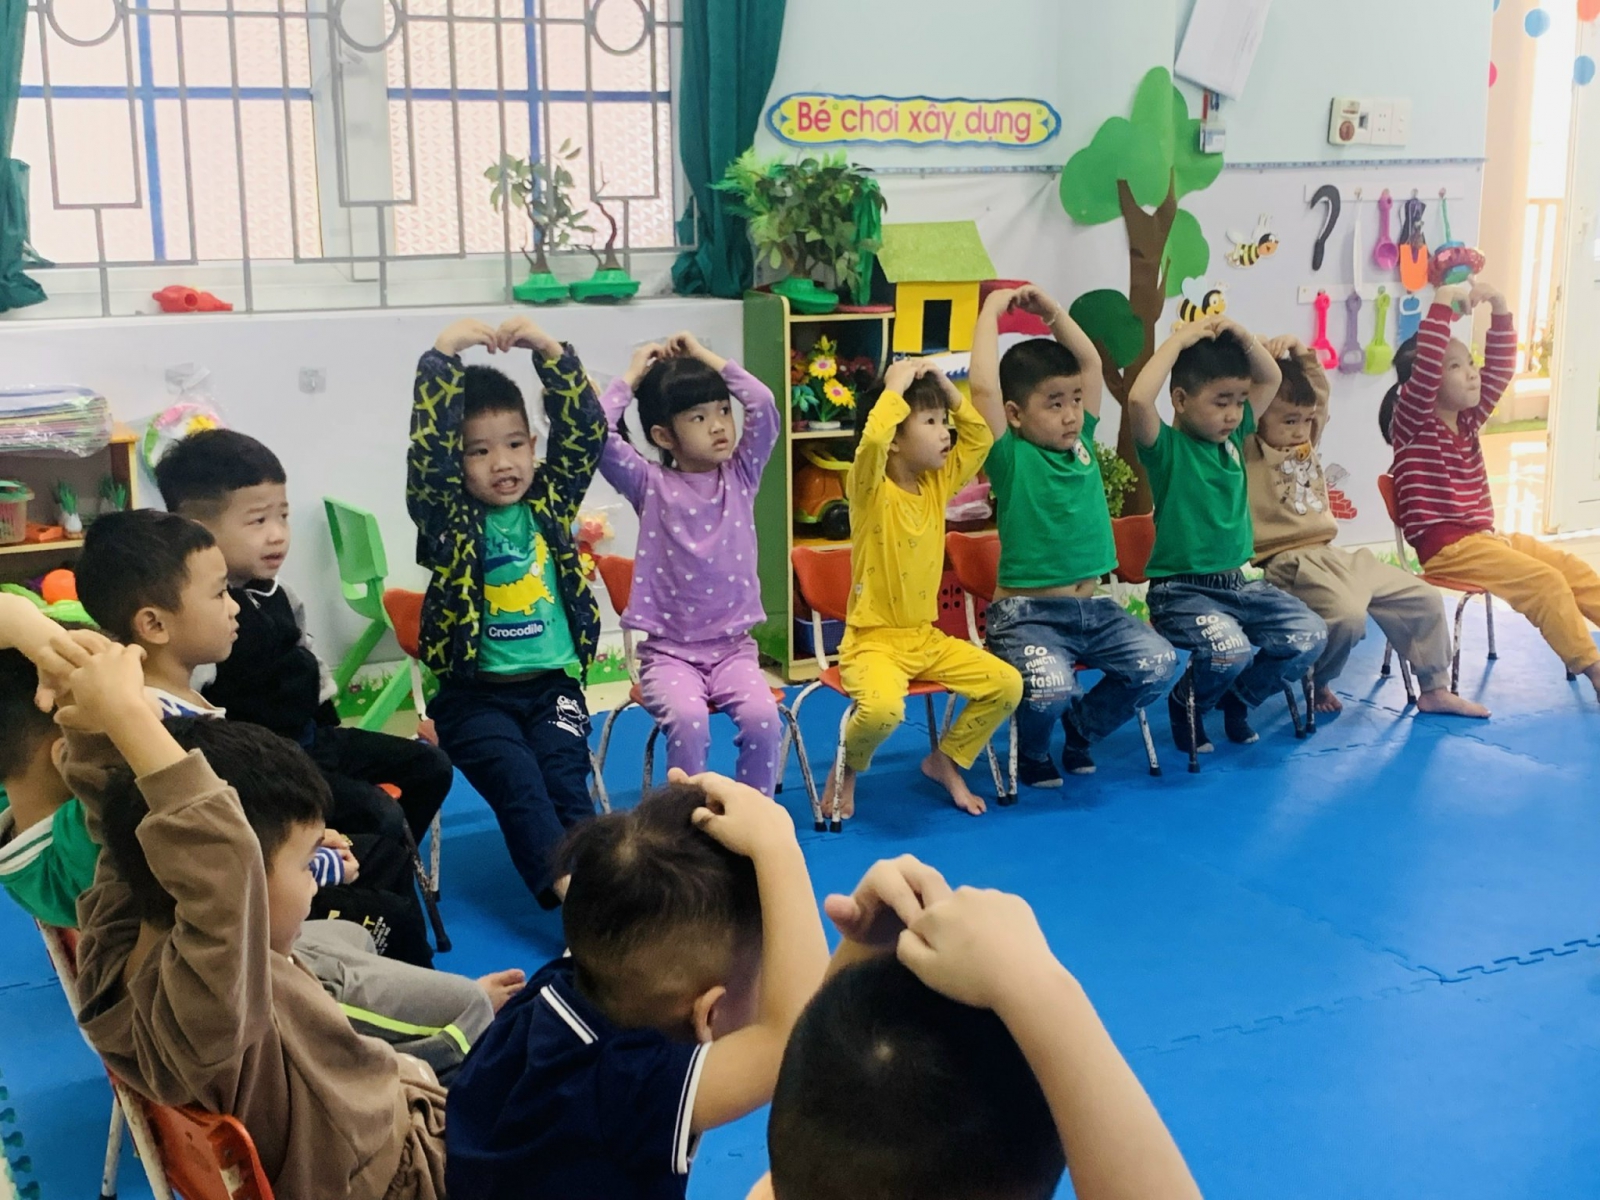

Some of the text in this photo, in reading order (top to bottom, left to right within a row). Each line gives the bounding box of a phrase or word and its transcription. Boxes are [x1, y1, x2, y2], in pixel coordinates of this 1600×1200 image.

[797, 100, 1032, 143] Bé chơi xây dựng
[1195, 614, 1219, 626] GO
[488, 622, 543, 638] Crocodile
[1024, 644, 1048, 656] GO
[1030, 671, 1065, 689] fashi
